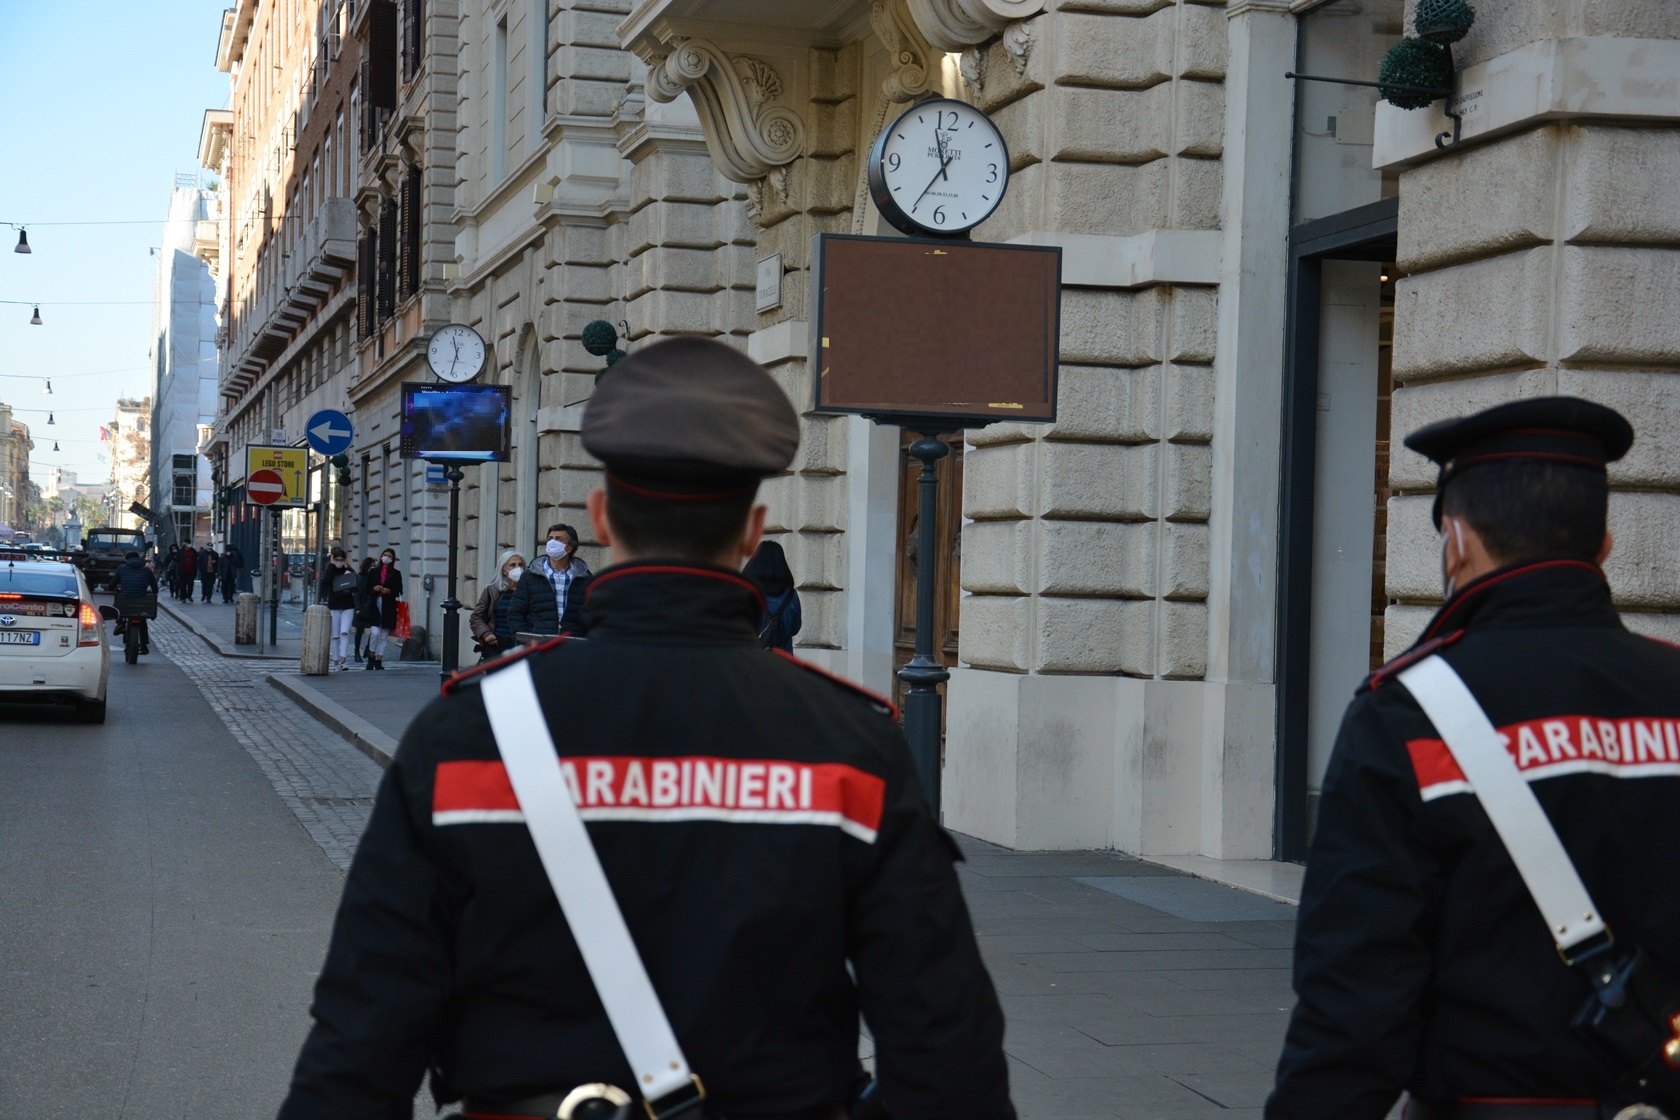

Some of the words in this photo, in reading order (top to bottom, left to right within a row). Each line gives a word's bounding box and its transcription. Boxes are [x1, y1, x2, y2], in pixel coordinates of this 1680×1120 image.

[936, 110, 959, 132] 12
[888, 152, 901, 173] 9
[986, 163, 998, 184] 3
[933, 204, 946, 226] 6
[454, 329, 463, 337] 12
[432, 347, 437, 355] 9
[452, 371, 458, 379] 6
[277, 460, 295, 468] STORE
[0, 632, 32, 643] 117NZ
[1496, 718, 1680, 767] ARABINI
[560, 761, 812, 809] ARABINIERI
